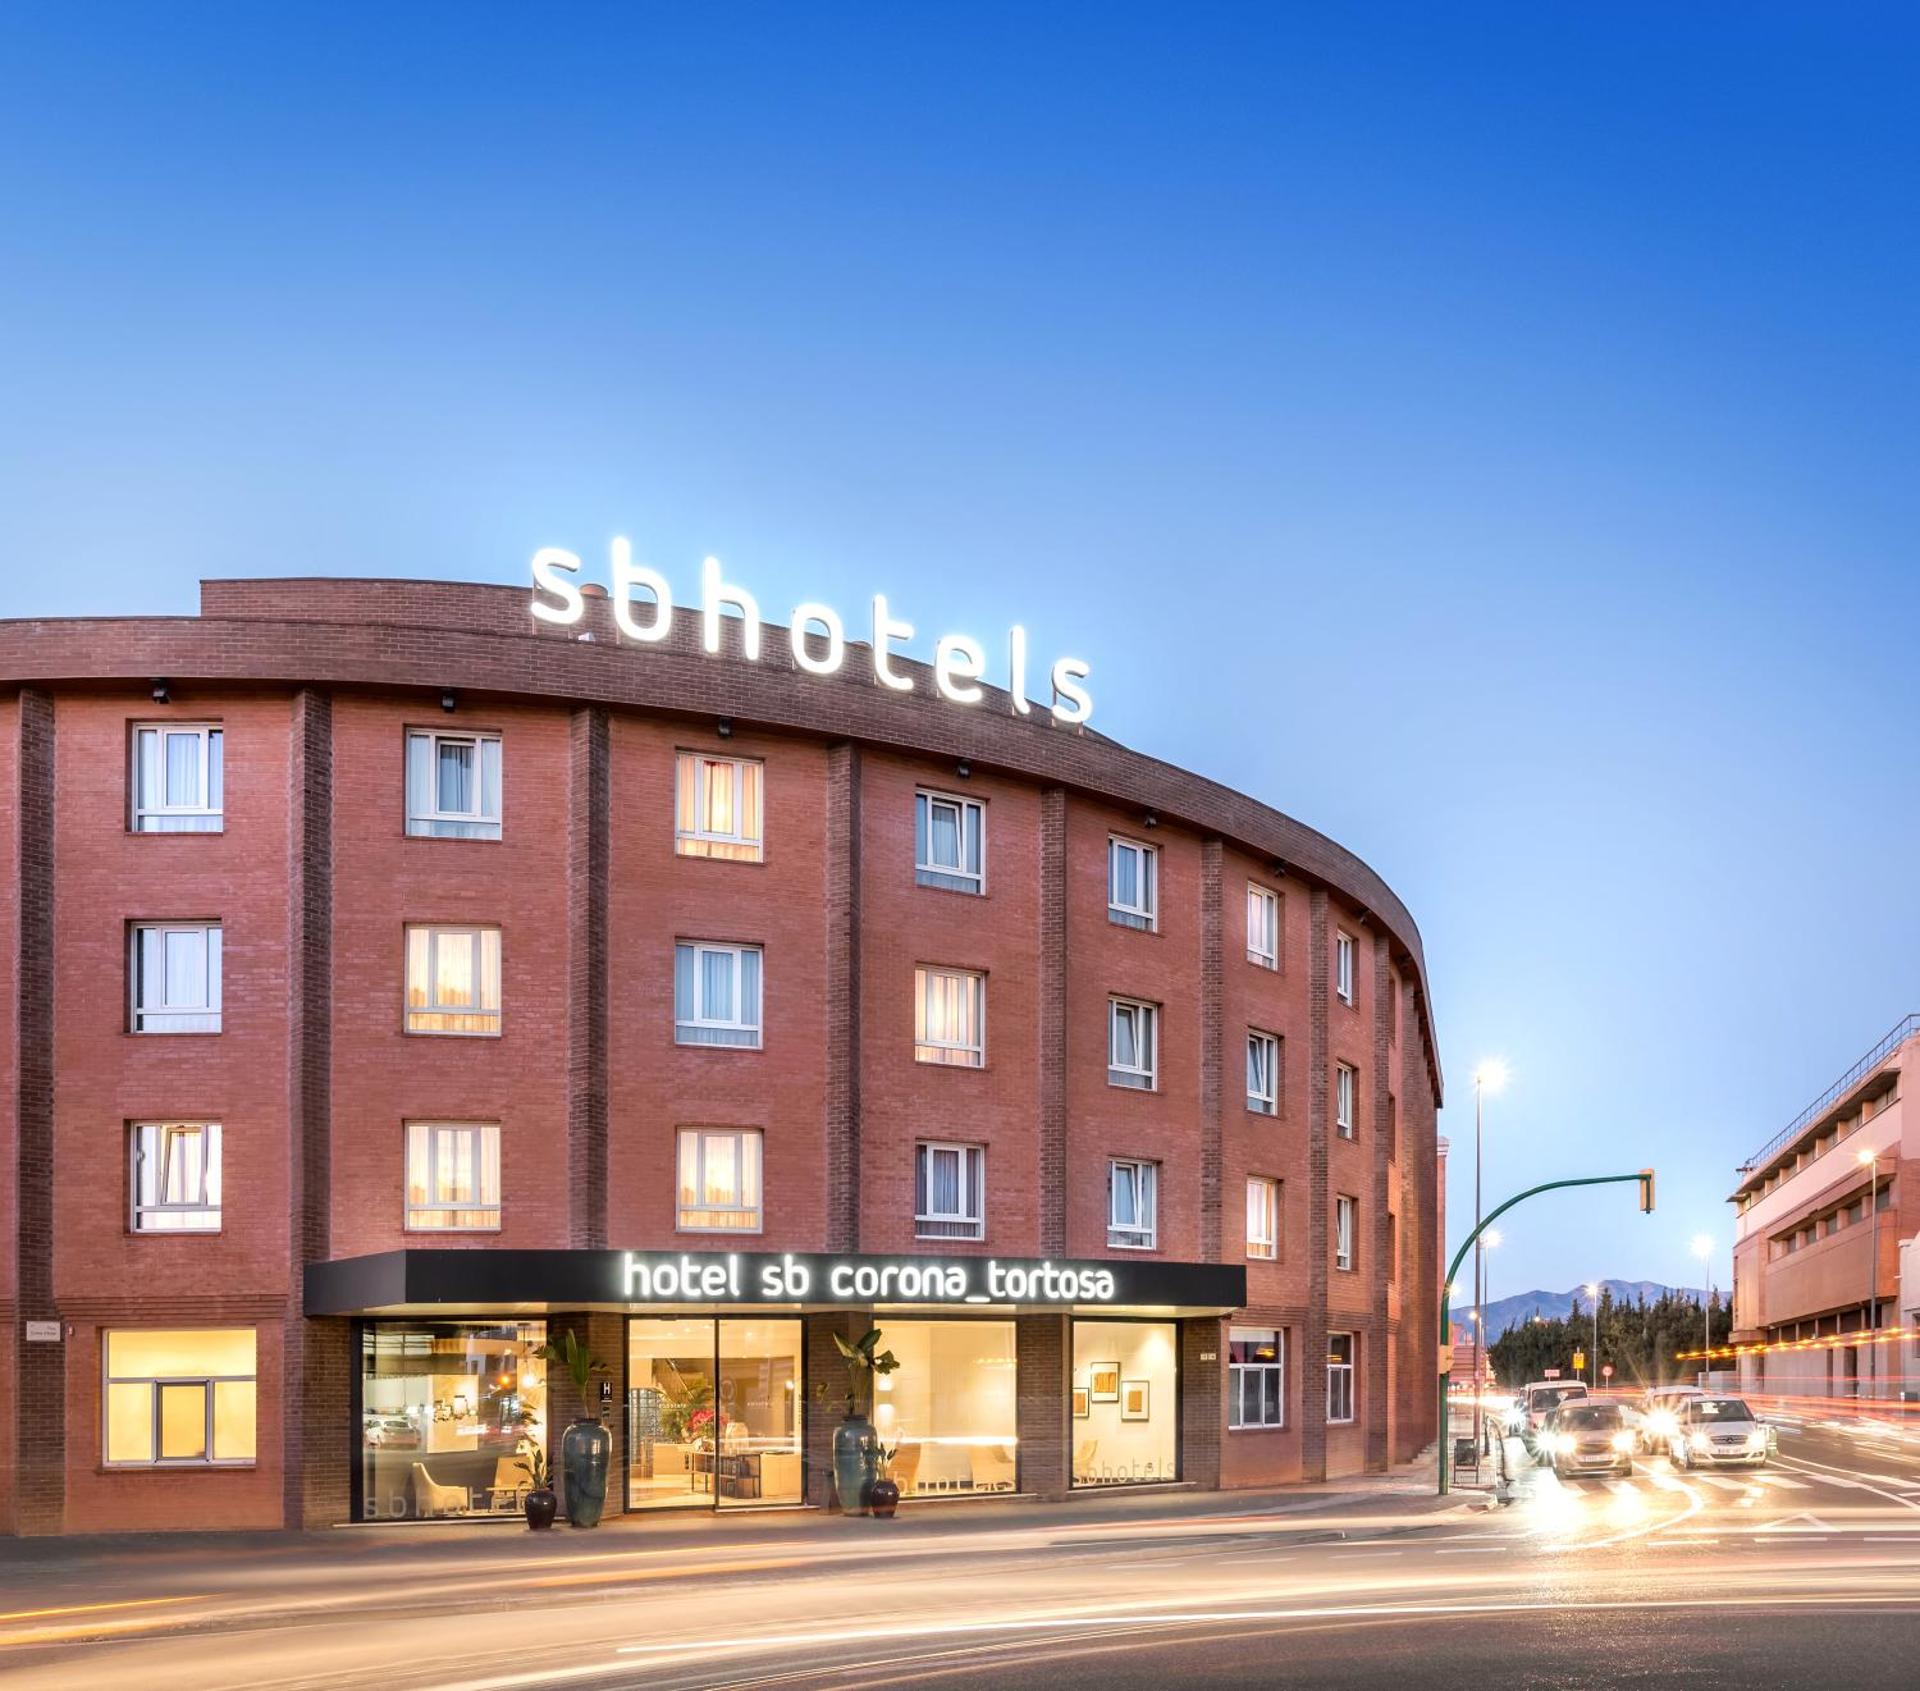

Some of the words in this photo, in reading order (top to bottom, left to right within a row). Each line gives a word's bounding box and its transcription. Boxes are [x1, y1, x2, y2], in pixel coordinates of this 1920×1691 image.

[623, 1252, 740, 1297] hotel
[761, 1254, 810, 1297] sb
[603, 1382, 610, 1395] H
